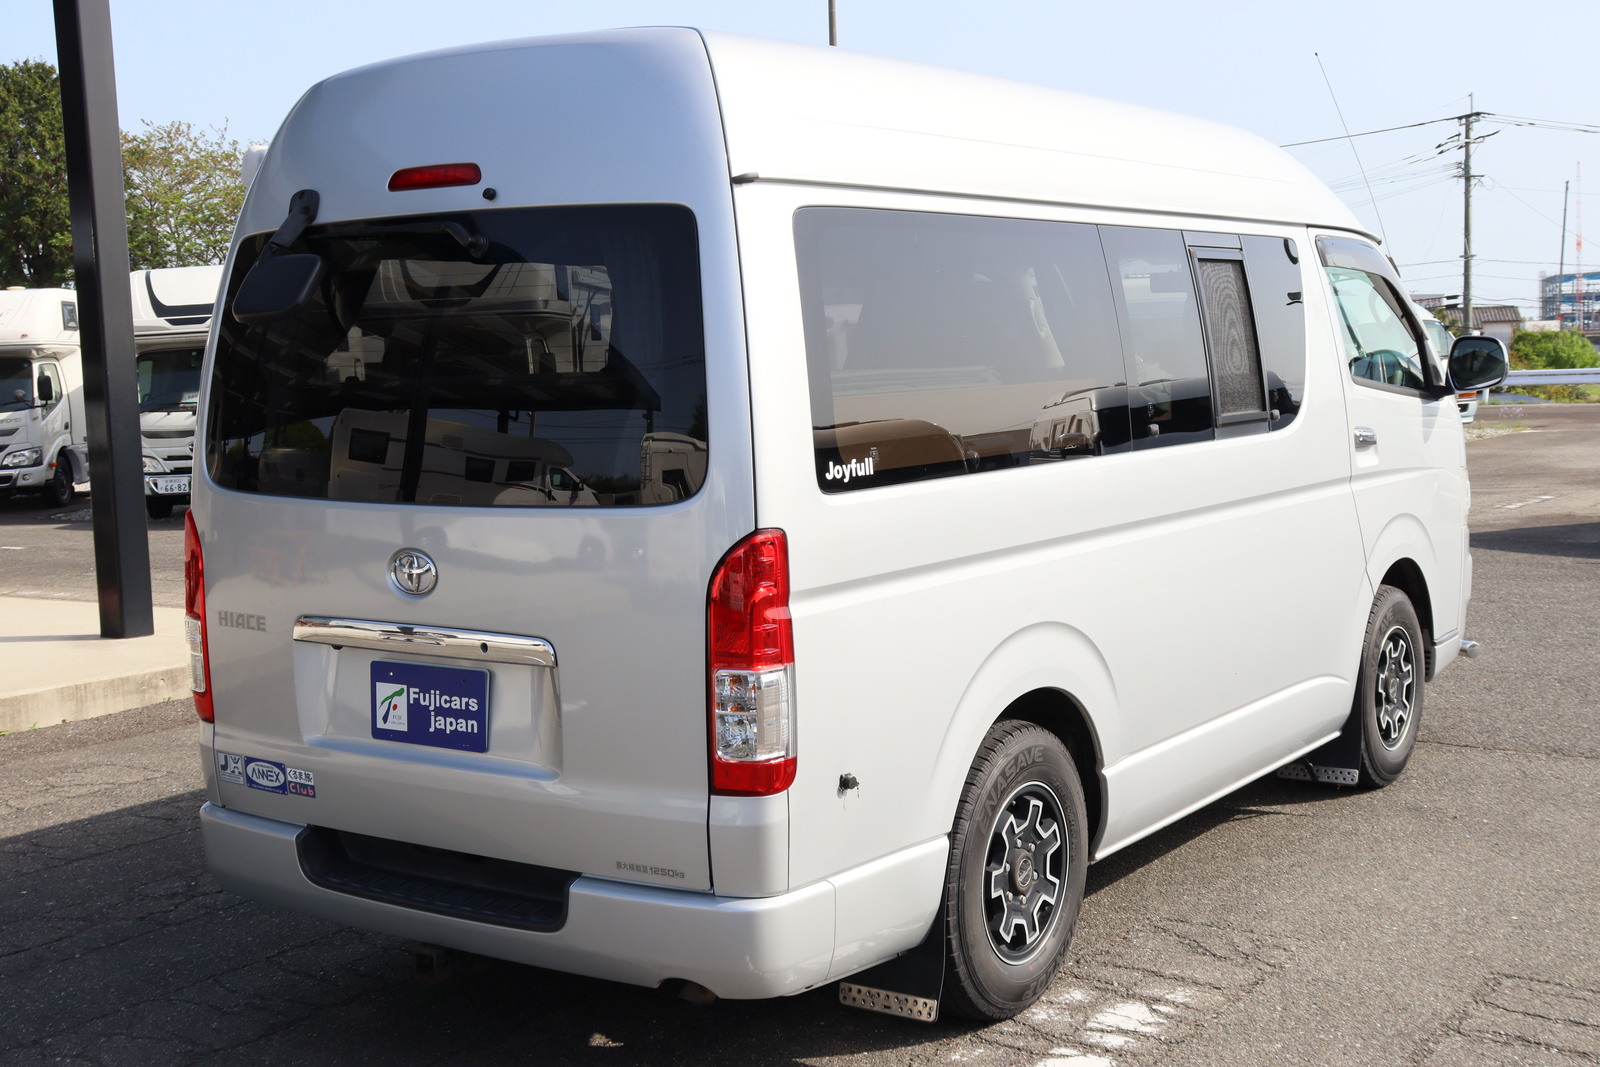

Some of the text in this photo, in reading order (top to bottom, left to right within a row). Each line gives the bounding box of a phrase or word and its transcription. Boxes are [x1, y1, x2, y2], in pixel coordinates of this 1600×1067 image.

[825, 457, 874, 483] Joyfull
[218, 611, 266, 632] HIACE
[409, 687, 479, 711] Fujicars
[429, 711, 478, 734] japan
[289, 782, 314, 796] Club
